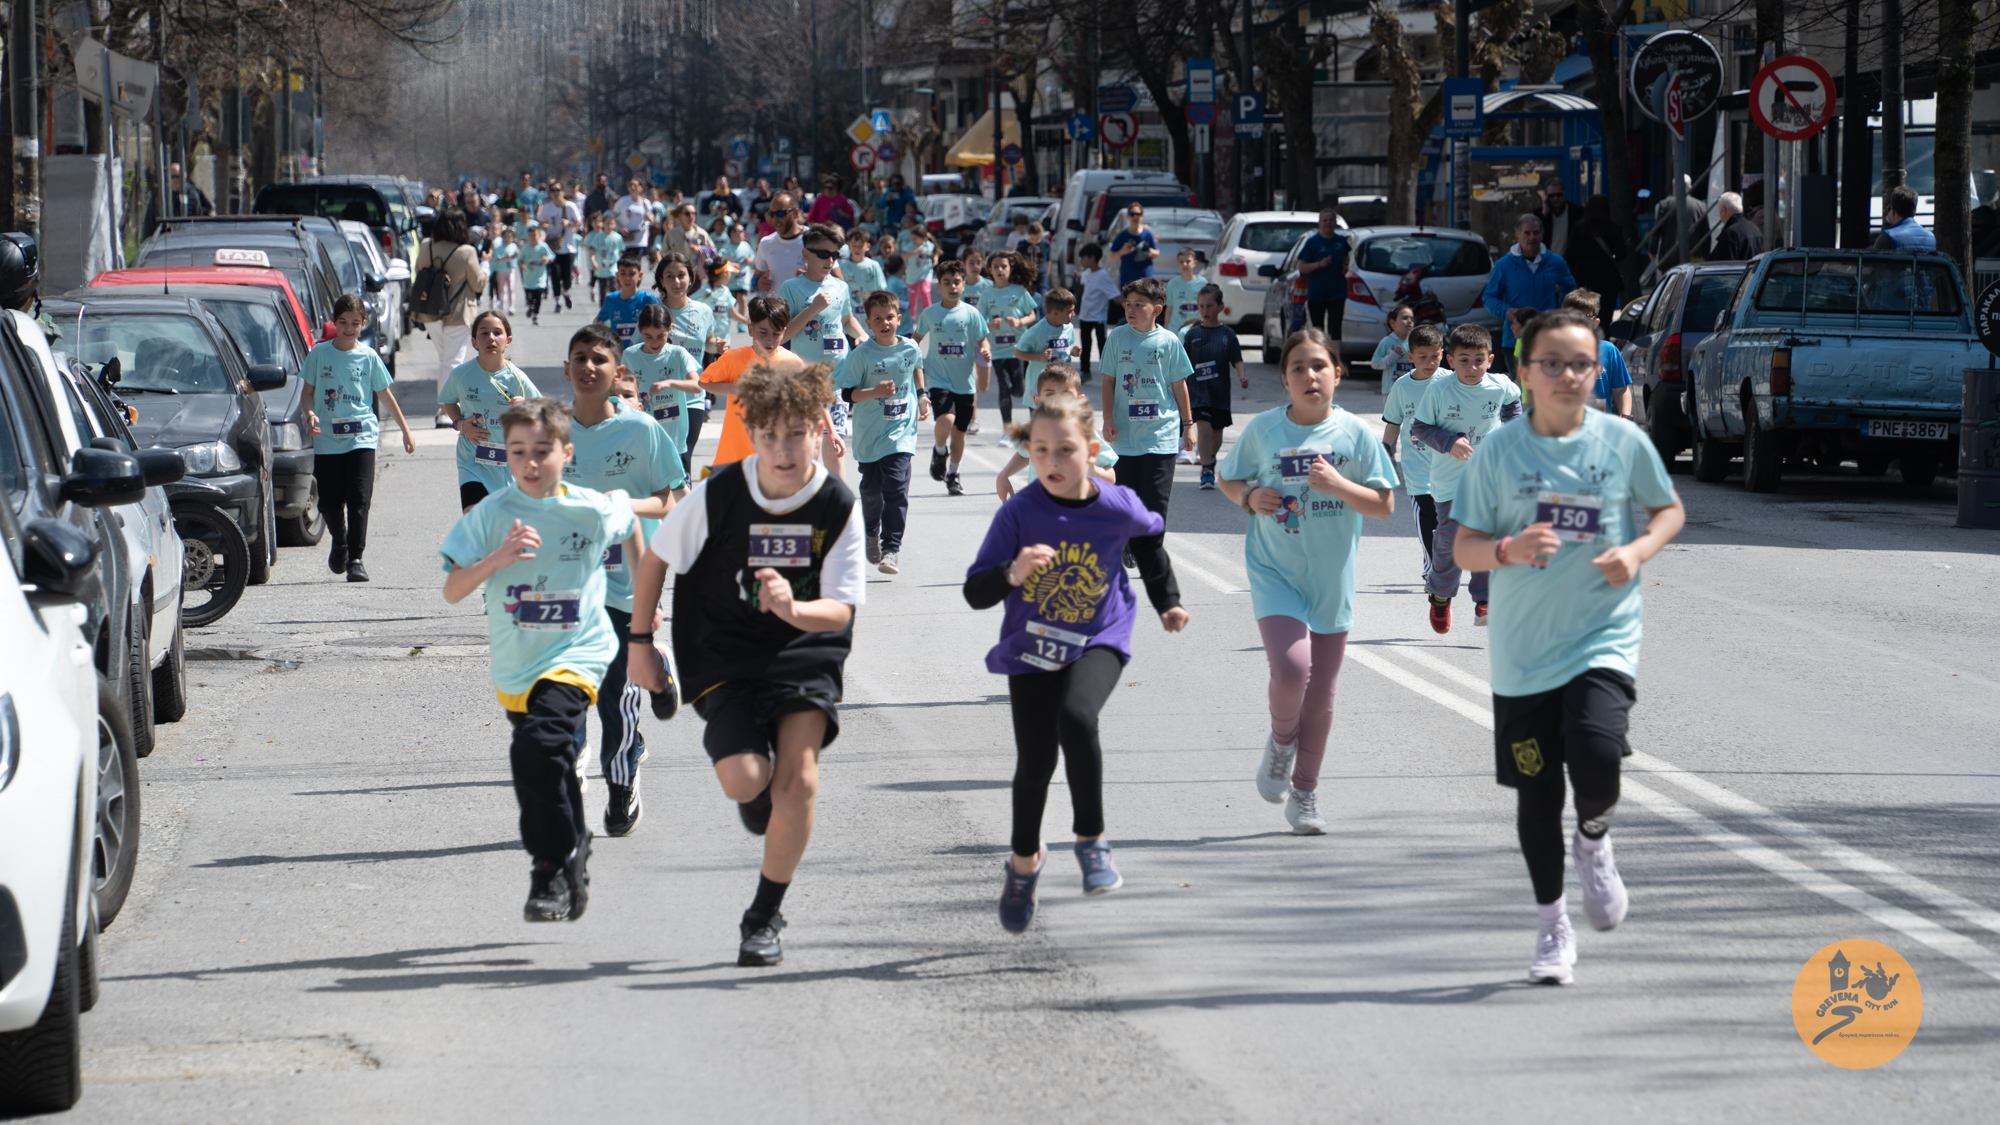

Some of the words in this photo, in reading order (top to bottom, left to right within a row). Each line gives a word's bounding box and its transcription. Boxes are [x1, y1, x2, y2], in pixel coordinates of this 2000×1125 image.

[1239, 95, 1257, 120] P
[222, 252, 261, 261] TAXI
[833, 340, 839, 349] 2
[1052, 340, 1066, 348] 155
[1201, 367, 1212, 376] 20
[343, 393, 361, 402] BPAN
[663, 409, 669, 418] 3
[891, 406, 902, 415] 43
[1138, 406, 1151, 415] 54
[833, 411, 846, 427] 26
[343, 423, 351, 433] 9
[1872, 421, 1901, 436] PNE
[1909, 423, 1947, 438] 3867
[488, 449, 496, 459] 8
[1292, 458, 1318, 474] 15
[1312, 500, 1344, 511] BPAN
[1312, 510, 1343, 518] HEROES
[1550, 507, 1589, 528] 150
[760, 538, 797, 555] 133
[538, 604, 564, 621] 72
[1035, 639, 1068, 662] 121
